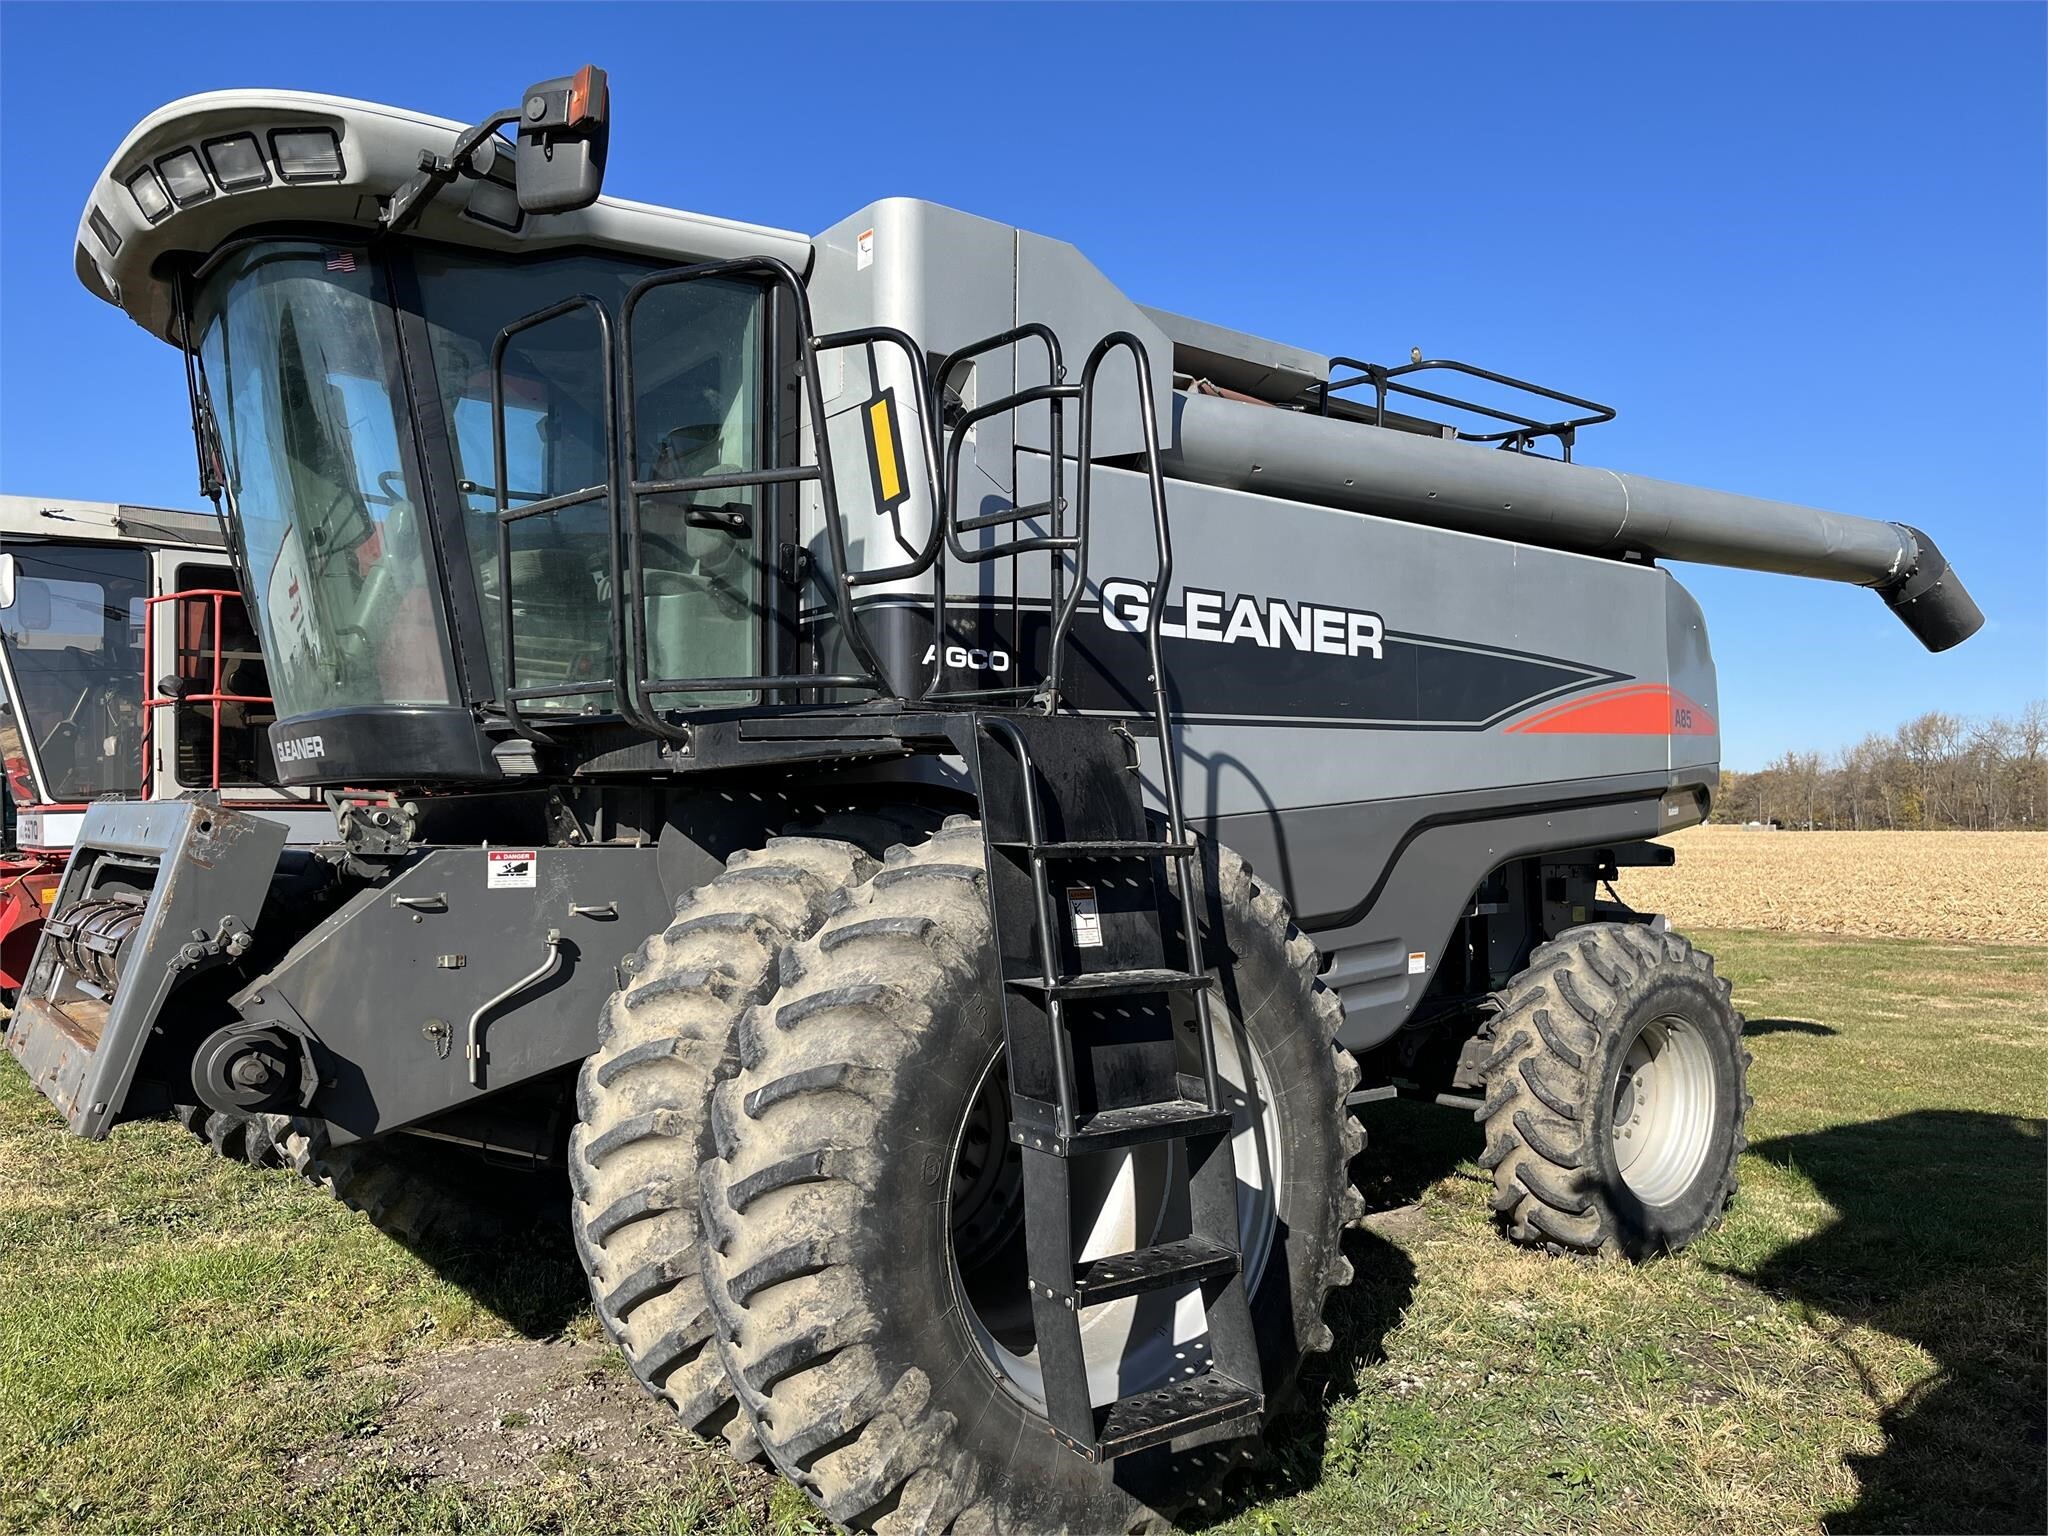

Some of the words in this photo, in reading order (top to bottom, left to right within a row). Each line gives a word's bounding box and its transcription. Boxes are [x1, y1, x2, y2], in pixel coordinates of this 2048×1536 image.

[1674, 708, 1692, 729] A85
[276, 735, 326, 763] GLEANER
[503, 852, 530, 860] DANGER
